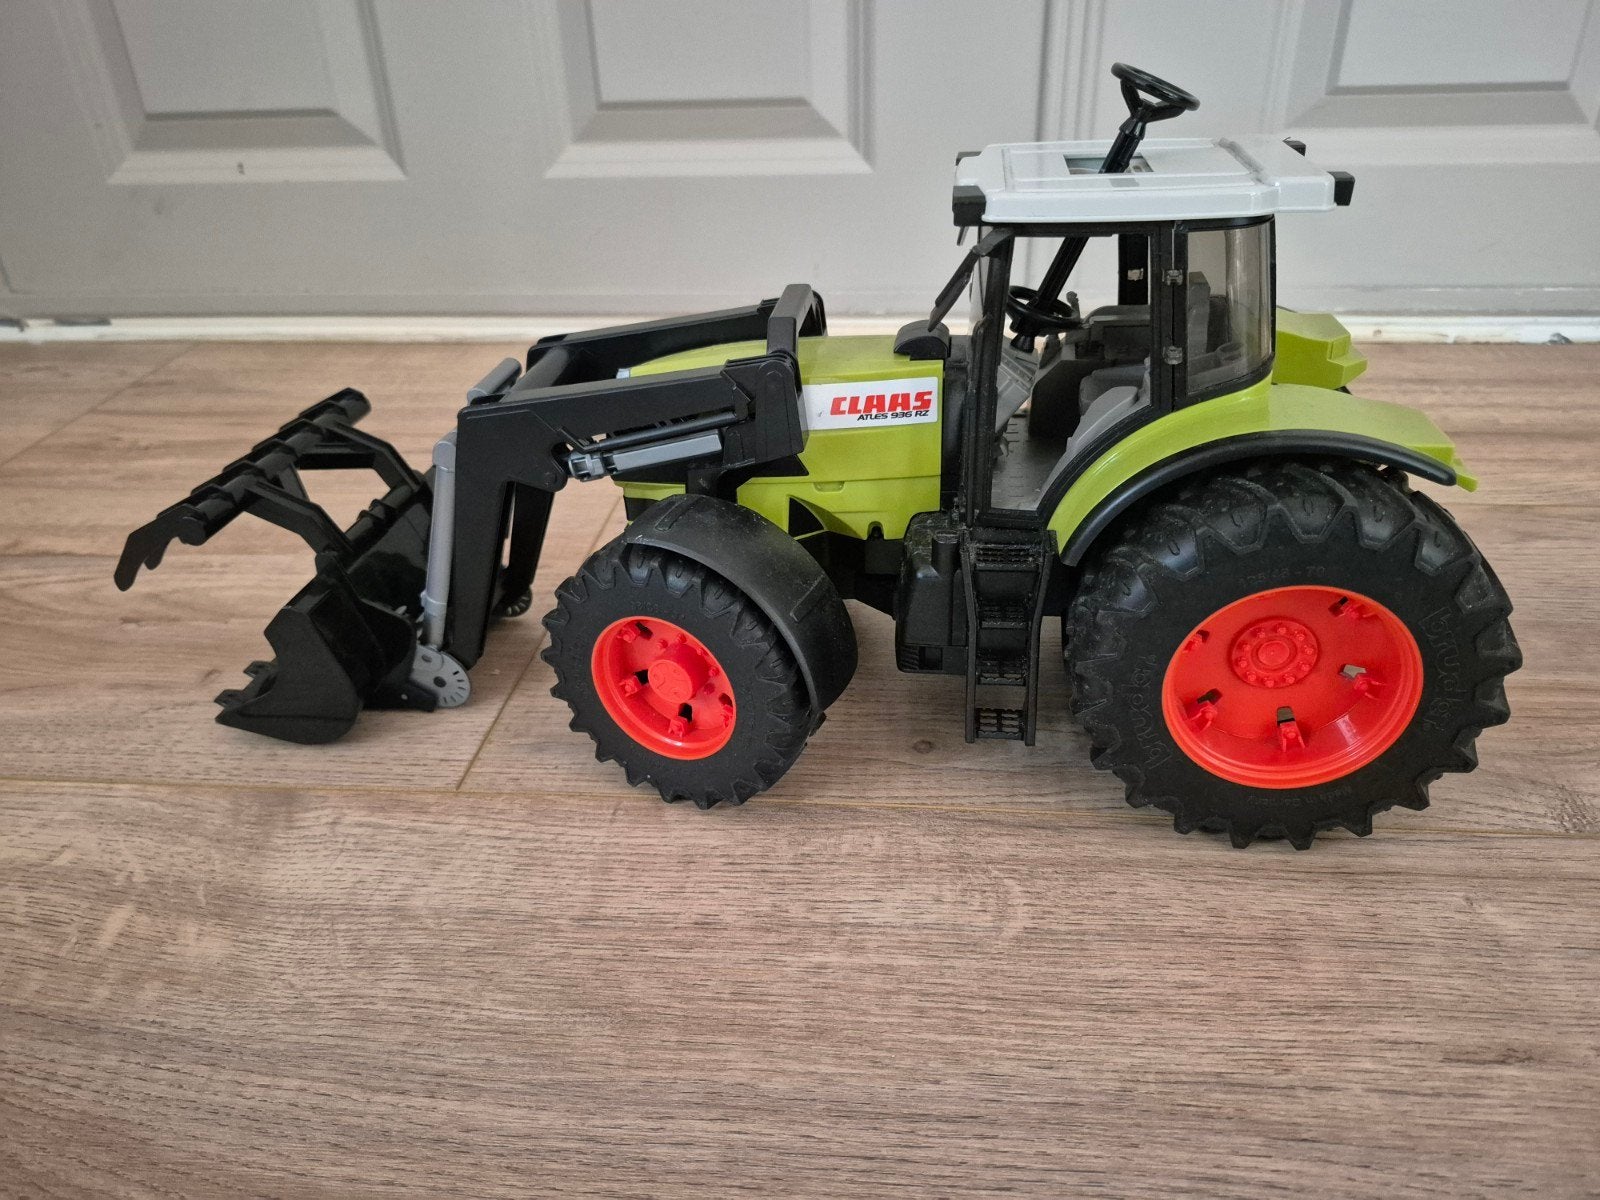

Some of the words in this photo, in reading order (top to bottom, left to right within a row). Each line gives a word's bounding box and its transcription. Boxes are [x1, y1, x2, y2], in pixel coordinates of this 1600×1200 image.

[830, 391, 933, 415] CLAAS
[857, 412, 888, 422] ATLES
[891, 411, 913, 419] 936
